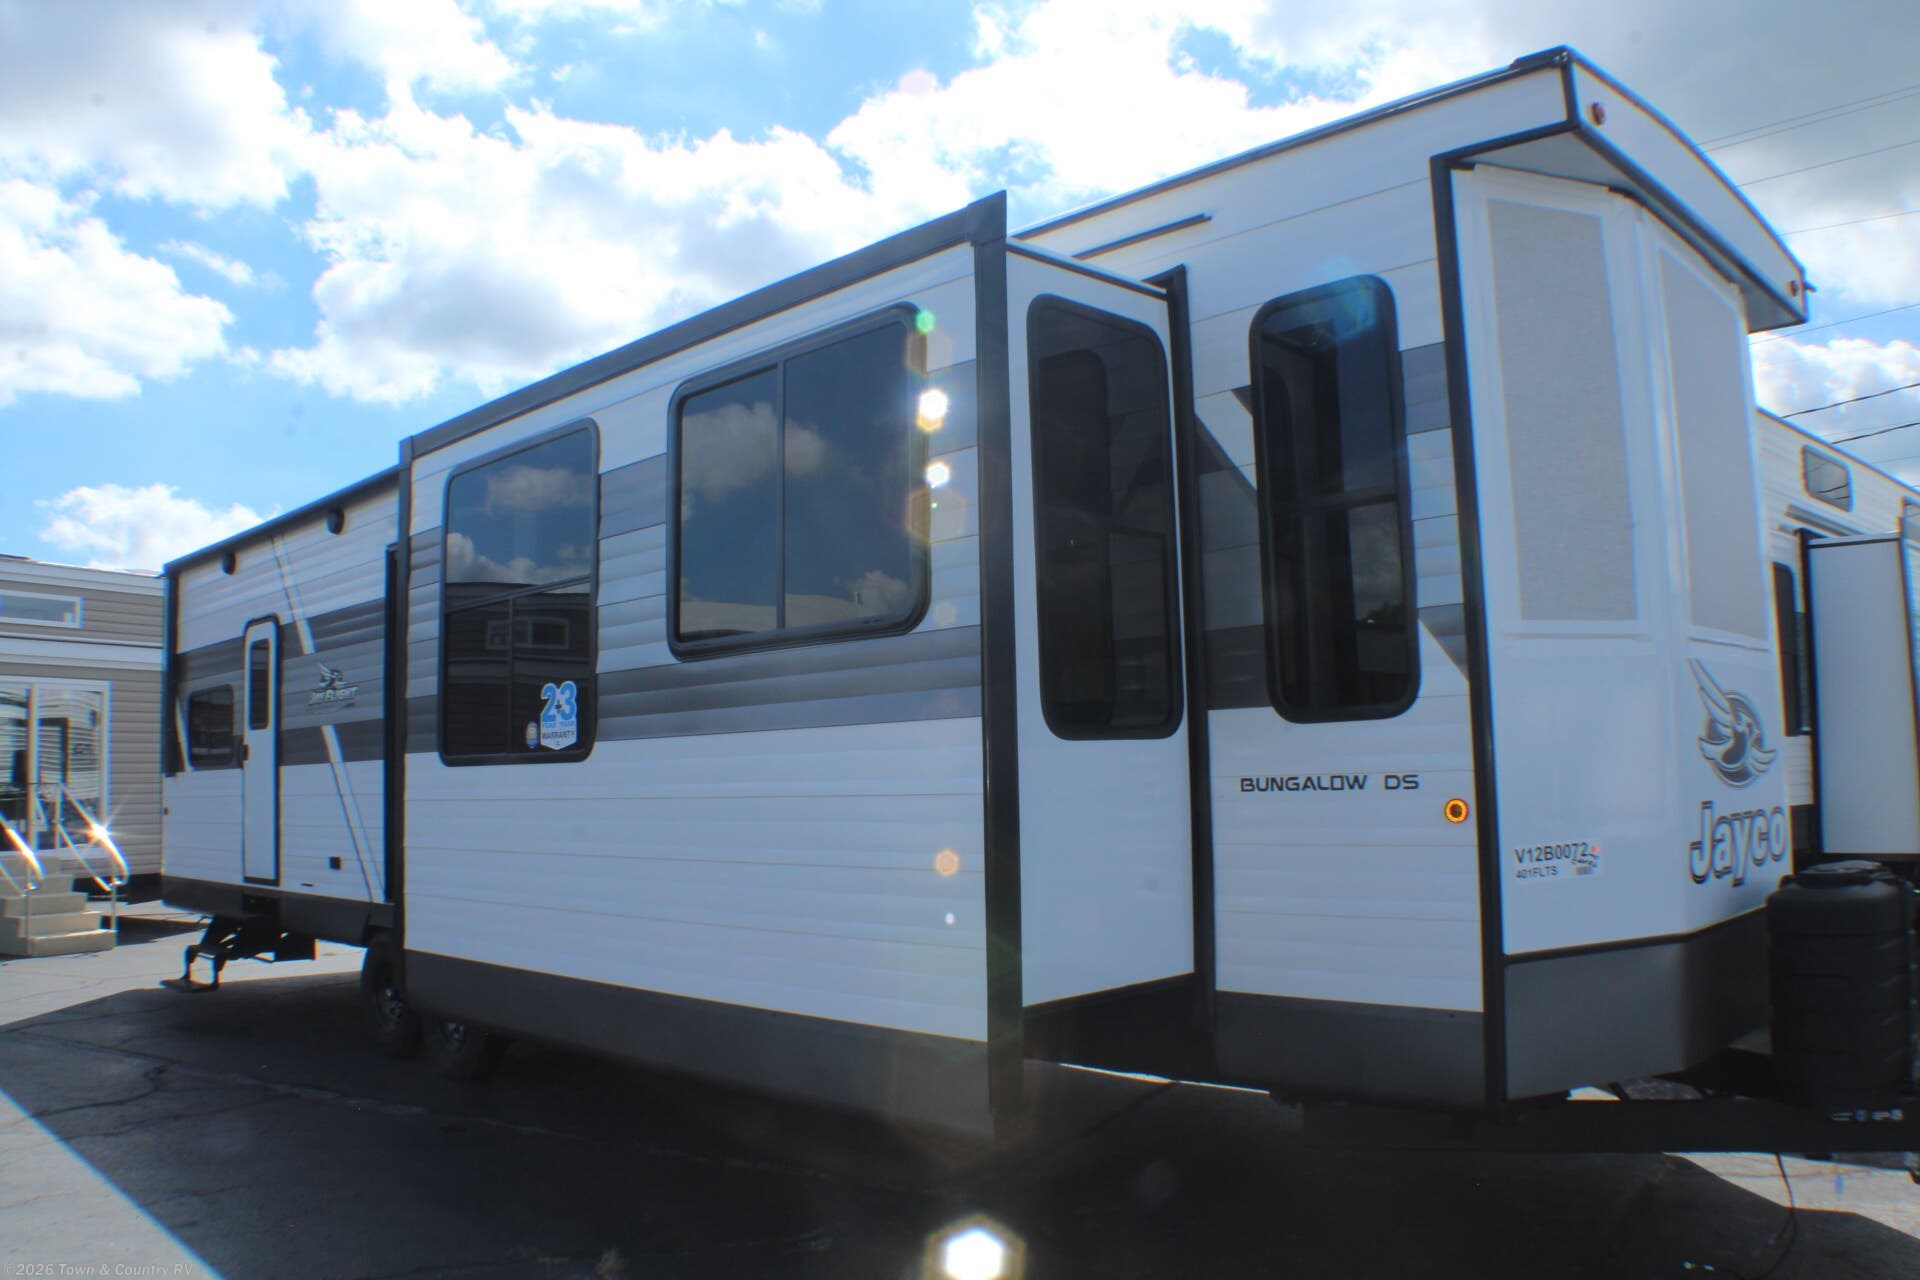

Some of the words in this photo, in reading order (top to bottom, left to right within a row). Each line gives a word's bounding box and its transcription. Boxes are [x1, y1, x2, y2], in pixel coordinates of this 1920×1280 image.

[1240, 774, 1368, 792] BUNGALOW
[1384, 774, 1419, 790] DS
[1514, 842, 1589, 864] V12B0072
[1689, 800, 1788, 888] Jayco
